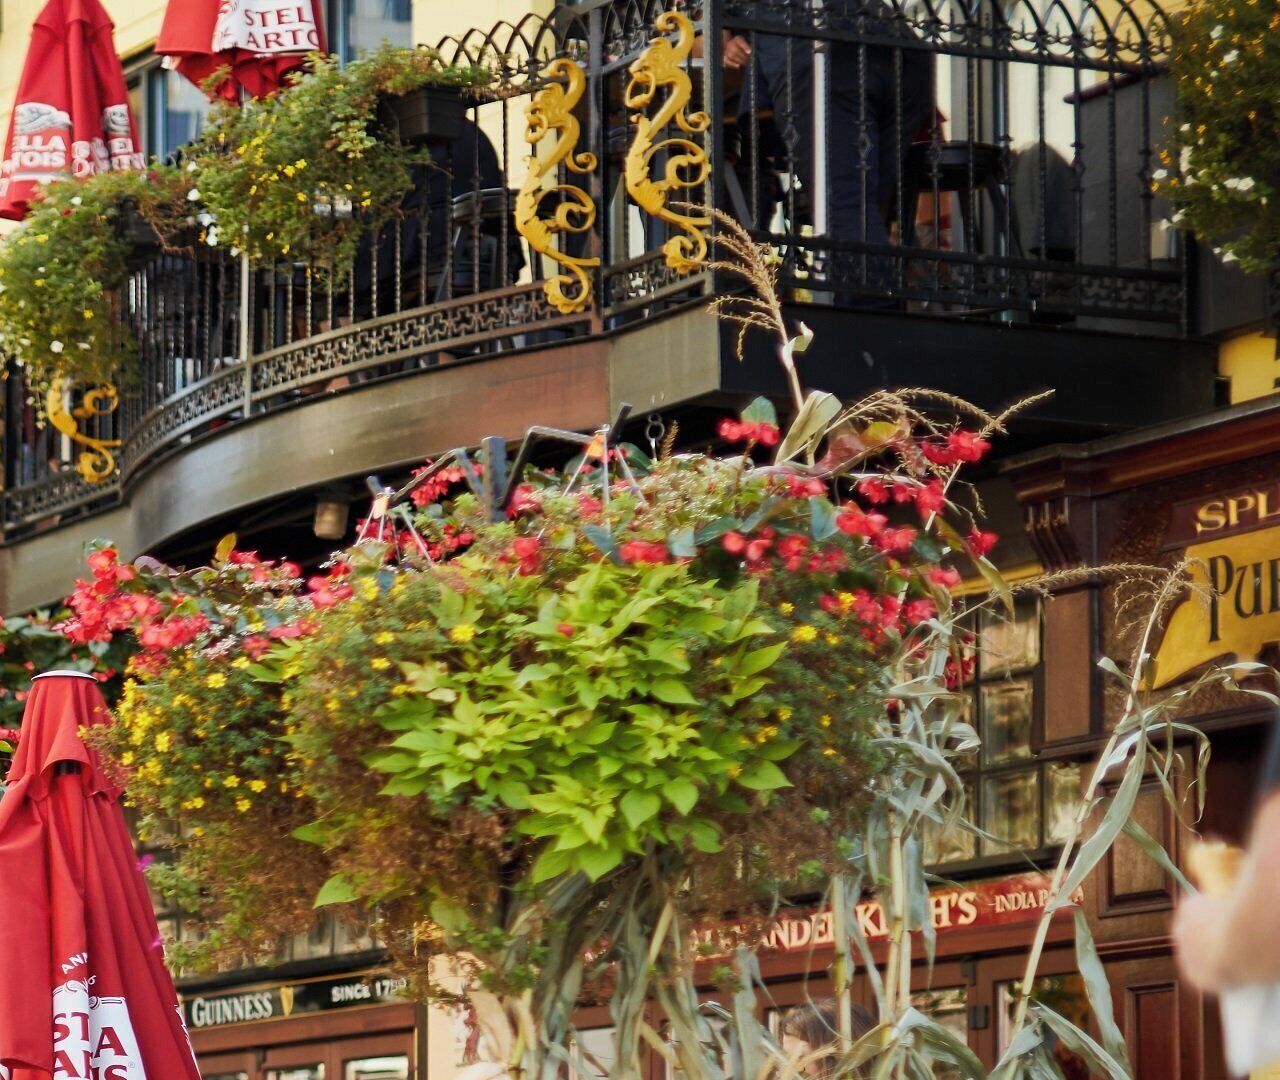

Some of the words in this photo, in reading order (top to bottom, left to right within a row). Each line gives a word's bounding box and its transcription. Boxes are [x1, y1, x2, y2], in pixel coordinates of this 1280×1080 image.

[244, 6, 313, 28] STEL
[246, 28, 320, 49] ARTO
[994, 890, 1038, 914] INDIA
[191, 991, 274, 1028] GUINNESS
